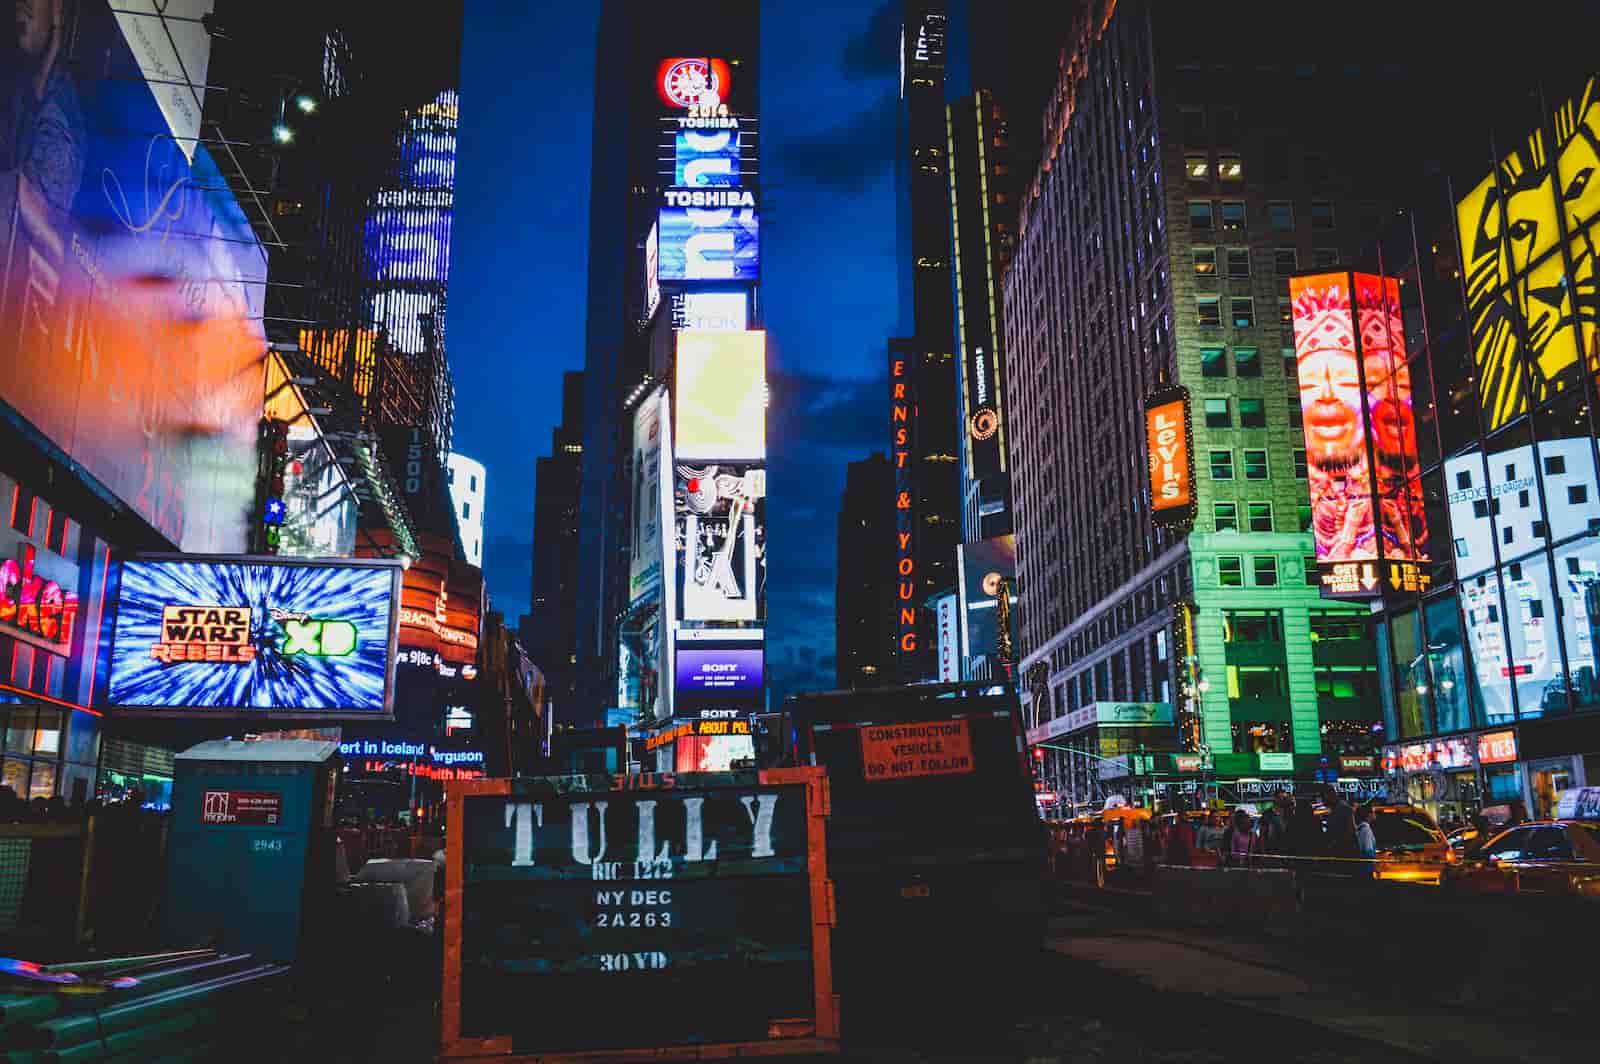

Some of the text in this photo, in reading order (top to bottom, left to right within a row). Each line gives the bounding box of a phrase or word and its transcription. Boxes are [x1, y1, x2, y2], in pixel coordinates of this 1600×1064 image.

[677, 118, 739, 128] TOSHIBA
[664, 192, 755, 206] TOSHIBA
[894, 361, 907, 468] ERNST
[899, 533, 917, 652] YOUNG
[166, 609, 247, 625] STAR
[166, 626, 246, 642] WARS
[283, 620, 356, 657] XD
[151, 643, 255, 664] REBELS
[701, 710, 739, 718] SONY
[699, 721, 728, 734] ABOUT
[869, 724, 960, 740] CONSTRUCTION
[364, 741, 378, 754] in
[381, 742, 424, 755] Iceland
[891, 741, 942, 756] VEHICLE
[867, 756, 969, 775] DO NOT FOLLOW
[505, 795, 778, 866] TULLY
[596, 890, 673, 905] NY DEC
[599, 952, 667, 971] 30 YD
